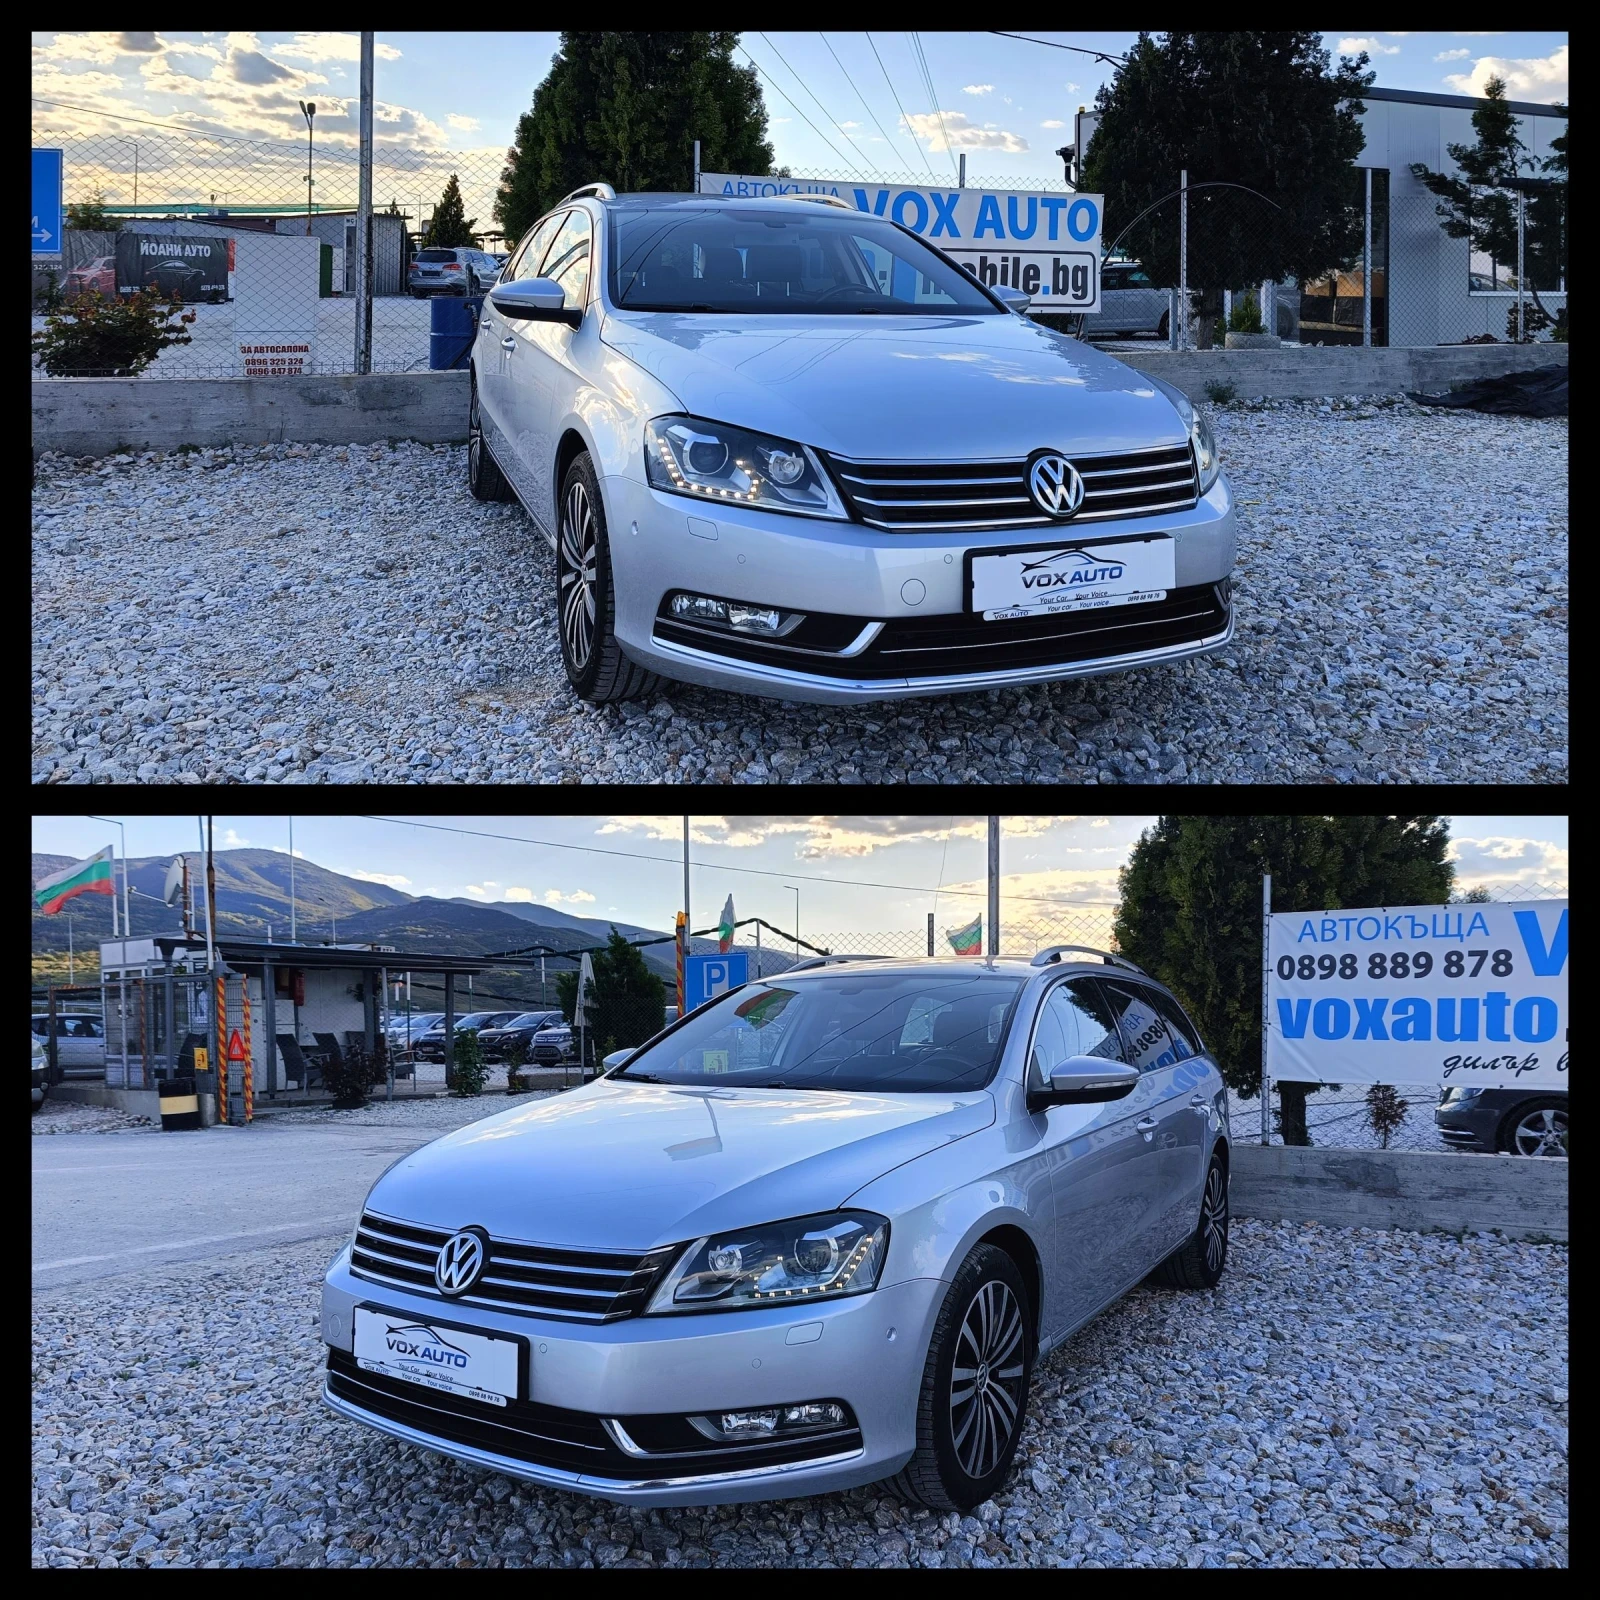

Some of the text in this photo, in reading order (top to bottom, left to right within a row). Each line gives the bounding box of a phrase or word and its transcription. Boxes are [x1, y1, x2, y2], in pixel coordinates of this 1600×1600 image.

[853, 188, 1099, 242] VOX AUTO
[140, 240, 211, 257] ЙОАНИ АУТО
[241, 345, 309, 354] ЗА АВТОСАЛОНА
[245, 357, 304, 366] 0896 325 324
[246, 367, 269, 375] 0896
[1297, 911, 1490, 943] АВТОКЪЩА
[1276, 949, 1514, 980] 0898 889 878
[706, 963, 726, 997] P
[1276, 991, 1568, 1043] voxauto
[1443, 1052, 1540, 1078] дилър
